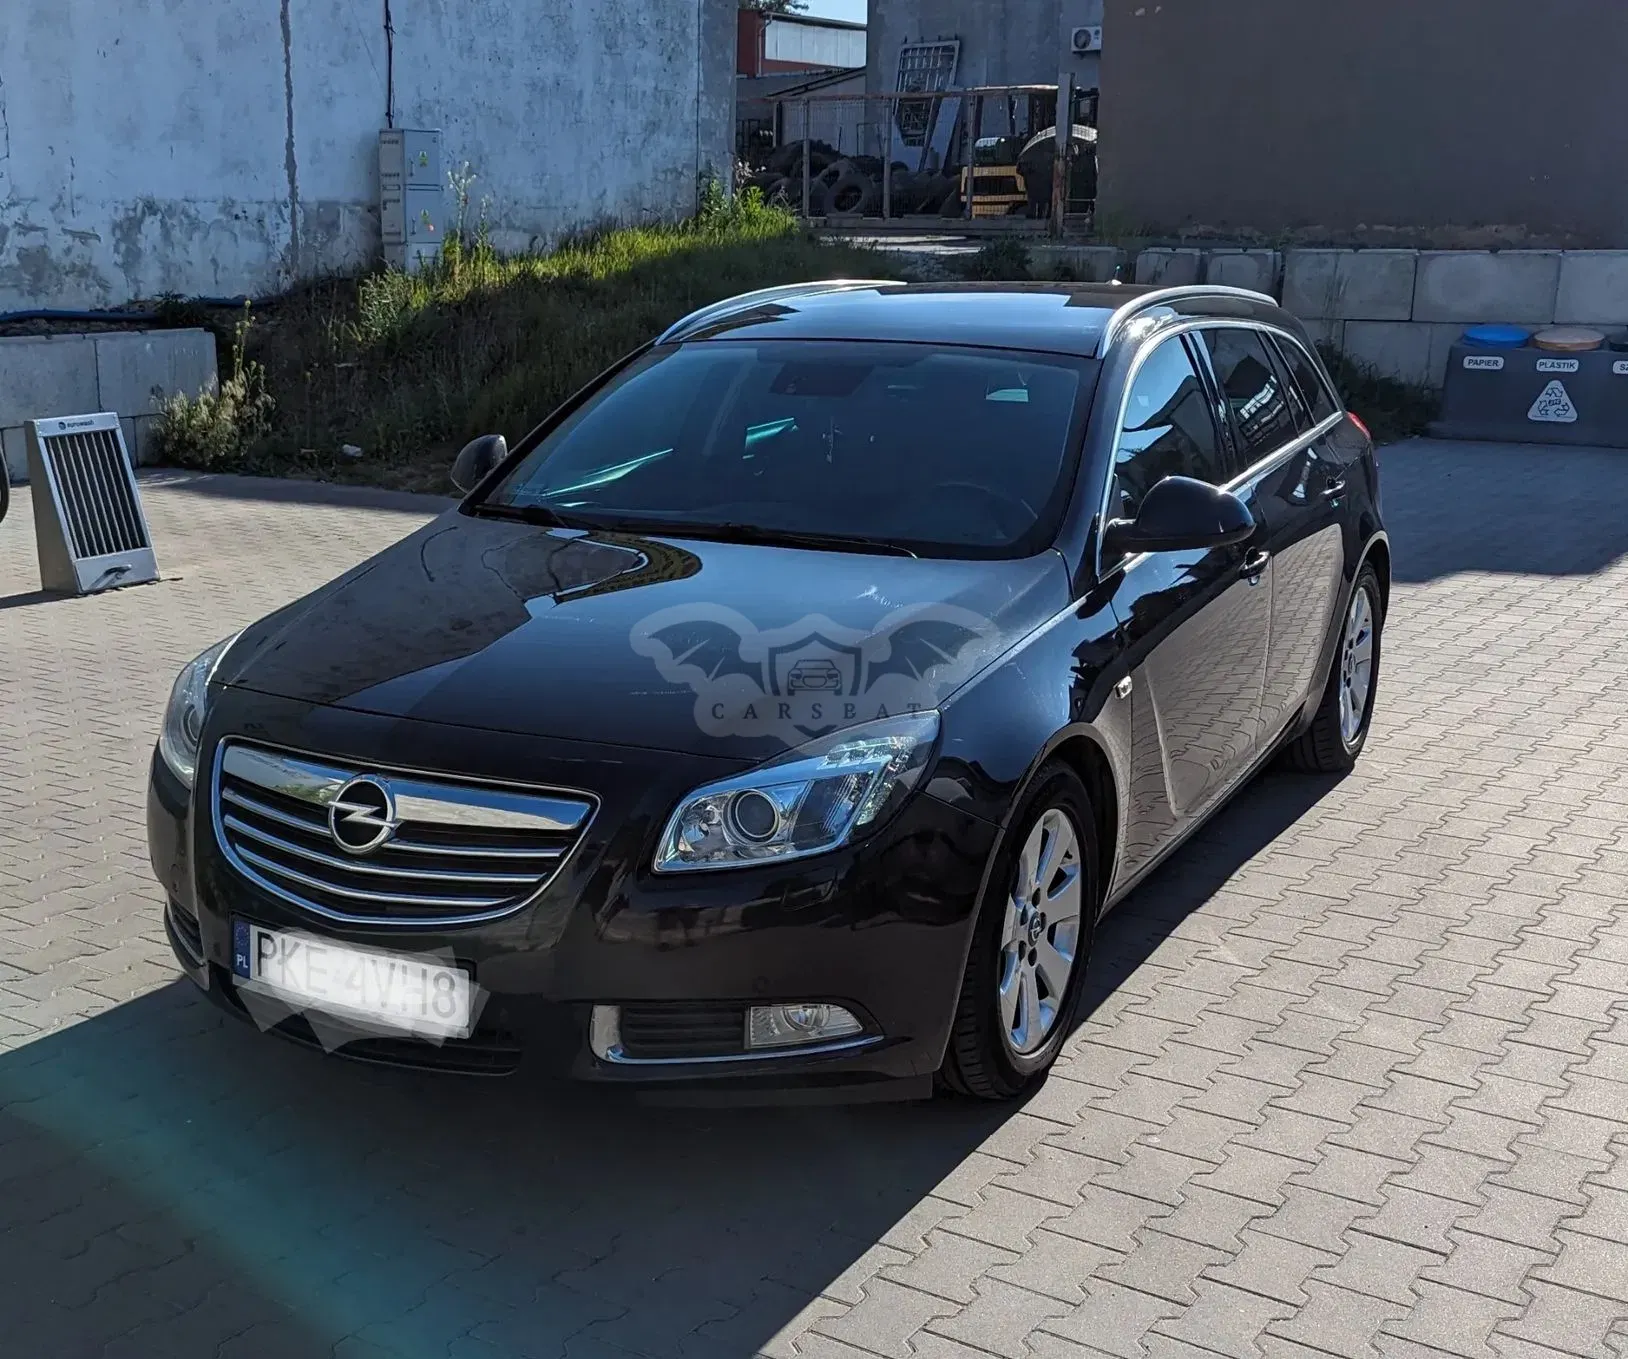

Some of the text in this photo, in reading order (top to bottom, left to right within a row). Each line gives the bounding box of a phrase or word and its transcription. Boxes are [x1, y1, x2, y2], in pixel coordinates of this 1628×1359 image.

[1467, 358, 1500, 368] PAPIER
[1538, 360, 1576, 370] PLASTIK
[236, 953, 249, 969] PL
